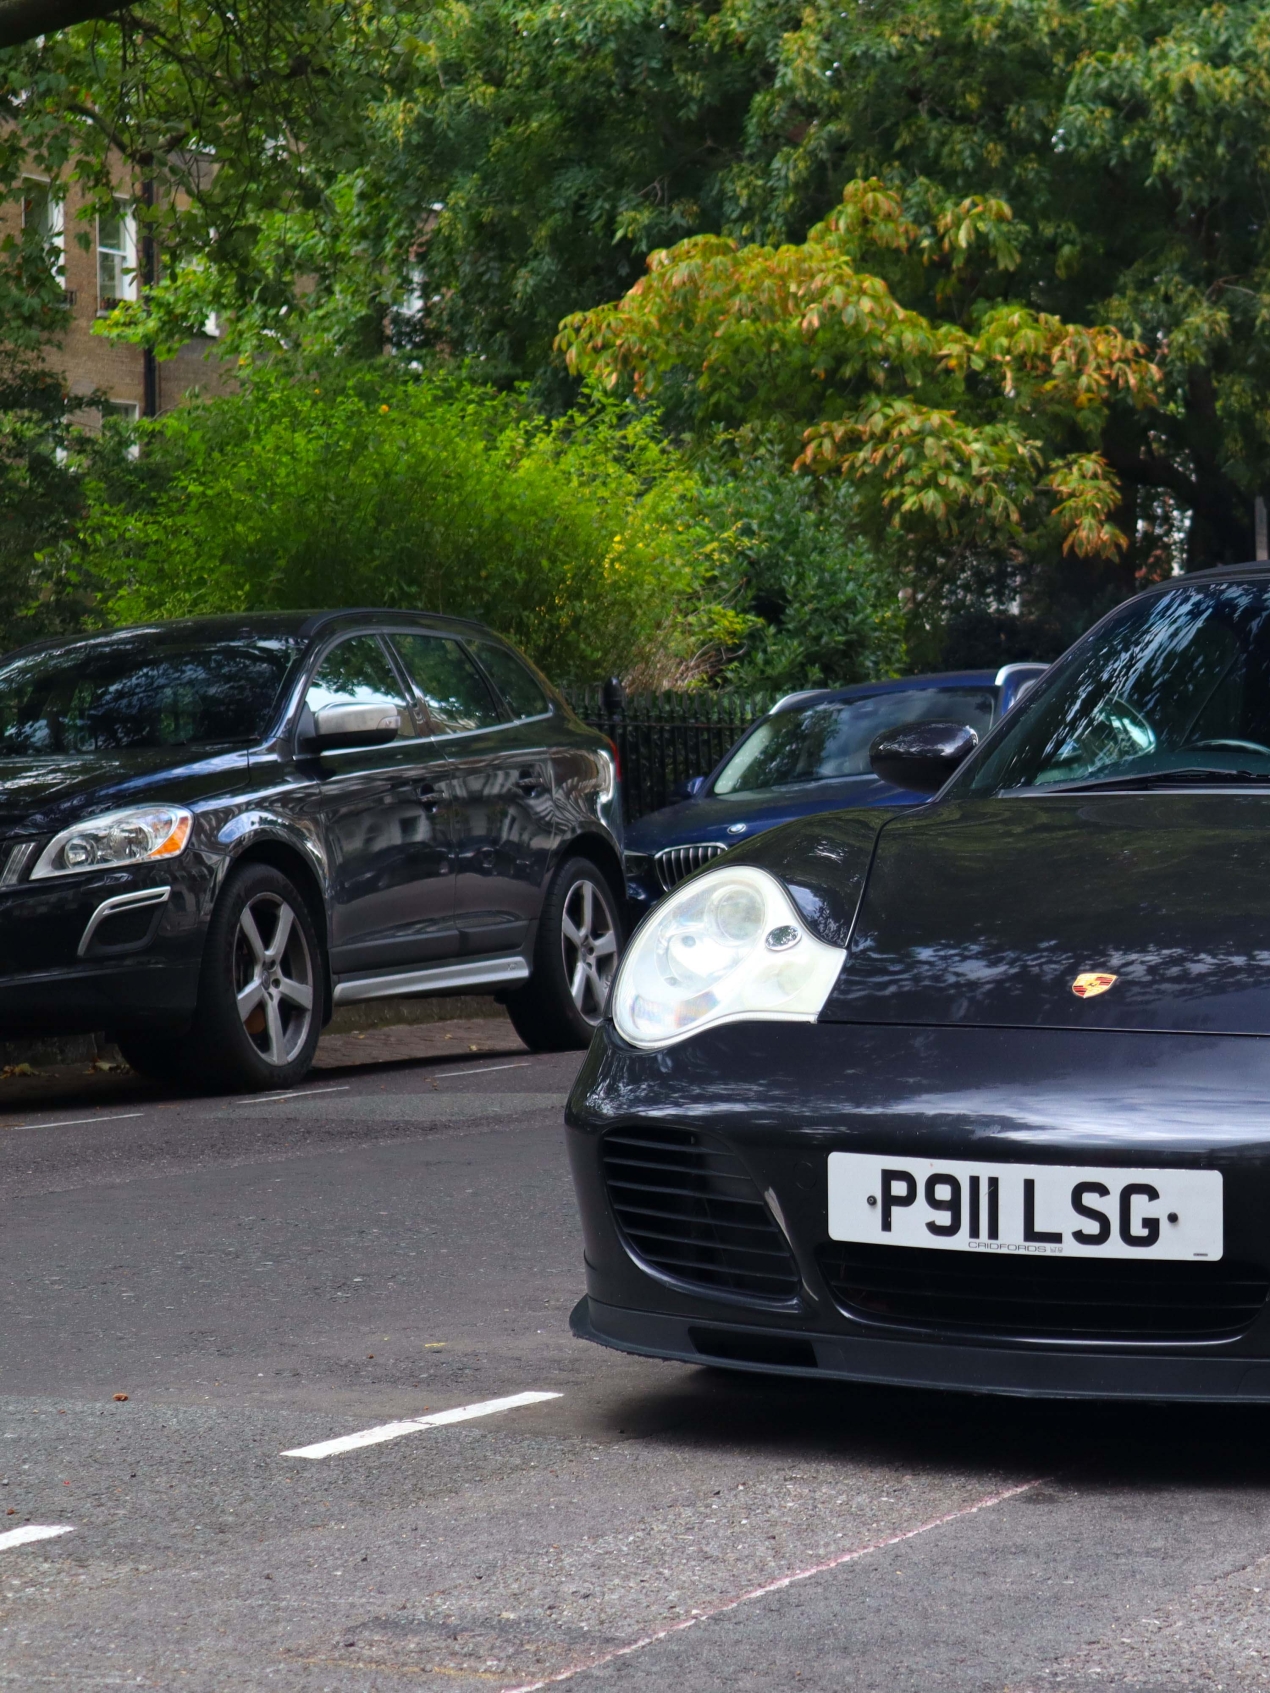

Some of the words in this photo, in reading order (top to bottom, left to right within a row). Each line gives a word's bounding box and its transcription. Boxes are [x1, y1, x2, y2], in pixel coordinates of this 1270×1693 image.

[880, 1167, 1000, 1241] P911
[1023, 1178, 1161, 1248] LSG
[967, 1241, 1047, 1253] CRIDFORDS
